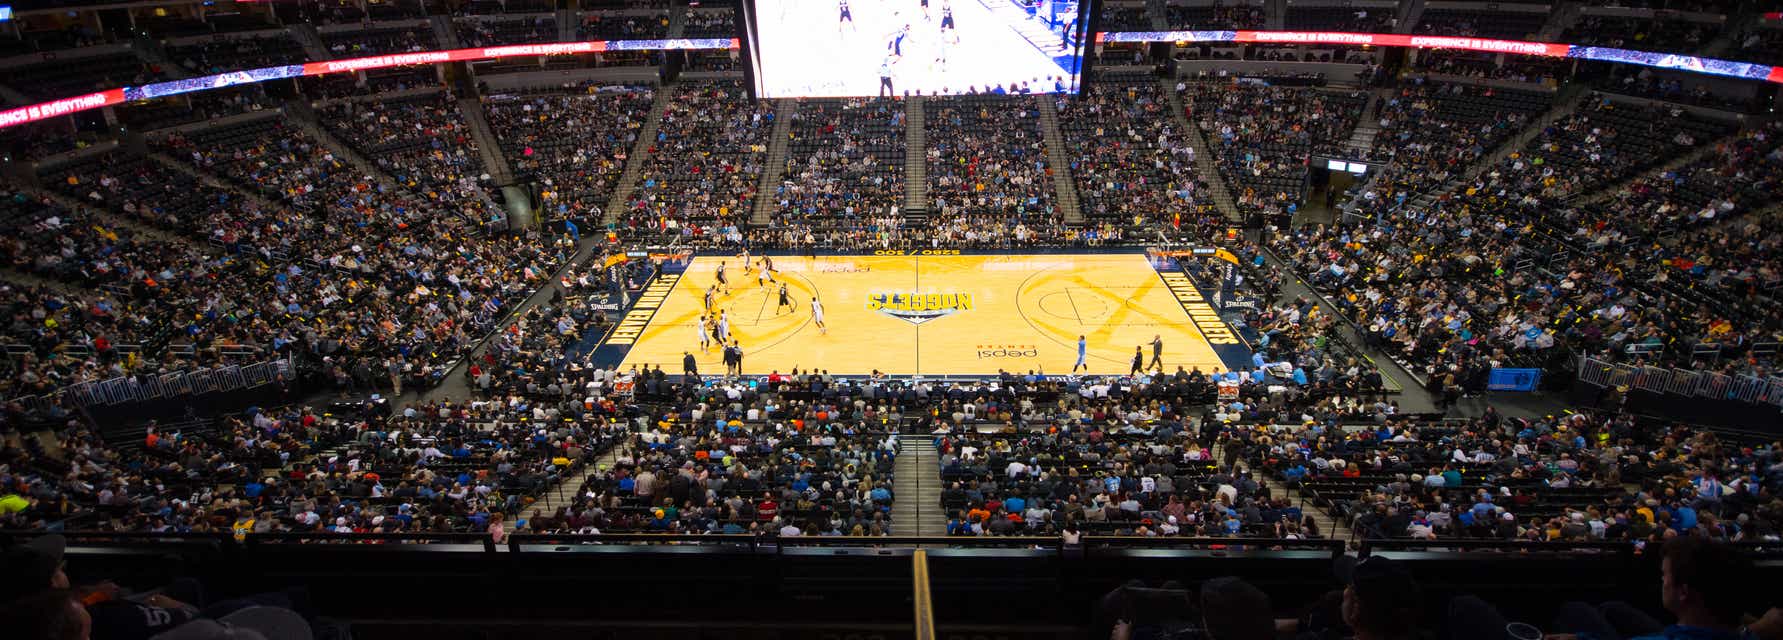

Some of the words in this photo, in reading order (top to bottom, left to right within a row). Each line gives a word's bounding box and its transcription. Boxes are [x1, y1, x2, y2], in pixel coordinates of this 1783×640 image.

[1256, 32, 1307, 41] EXPERIENCE
[1308, 33, 1317, 41] IS
[1318, 33, 1372, 43] EVERYTHING
[1411, 37, 1470, 48] EXPERIENCE
[1471, 39, 1482, 48] IS
[1482, 40, 1546, 53] EVERYTHING
[484, 46, 533, 57] EXPERIENCE
[543, 43, 591, 54] EVERYTHING
[328, 58, 383, 71] EXPERIENCE
[384, 57, 393, 66] IS
[394, 53, 448, 66] EVERYTHING
[29, 107, 40, 119] IS
[42, 94, 105, 116] EVERYTHING
[590, 303, 619, 311] SPALDING
[605, 309, 656, 345] DENVER
[633, 273, 680, 309] NUGGETS
[867, 293, 973, 310] NUGGETS
[1160, 271, 1204, 301] DENVER
[1183, 302, 1239, 345] NUGGETS
[1225, 301, 1255, 309] SPALDING
[977, 349, 1038, 360] pepsi
